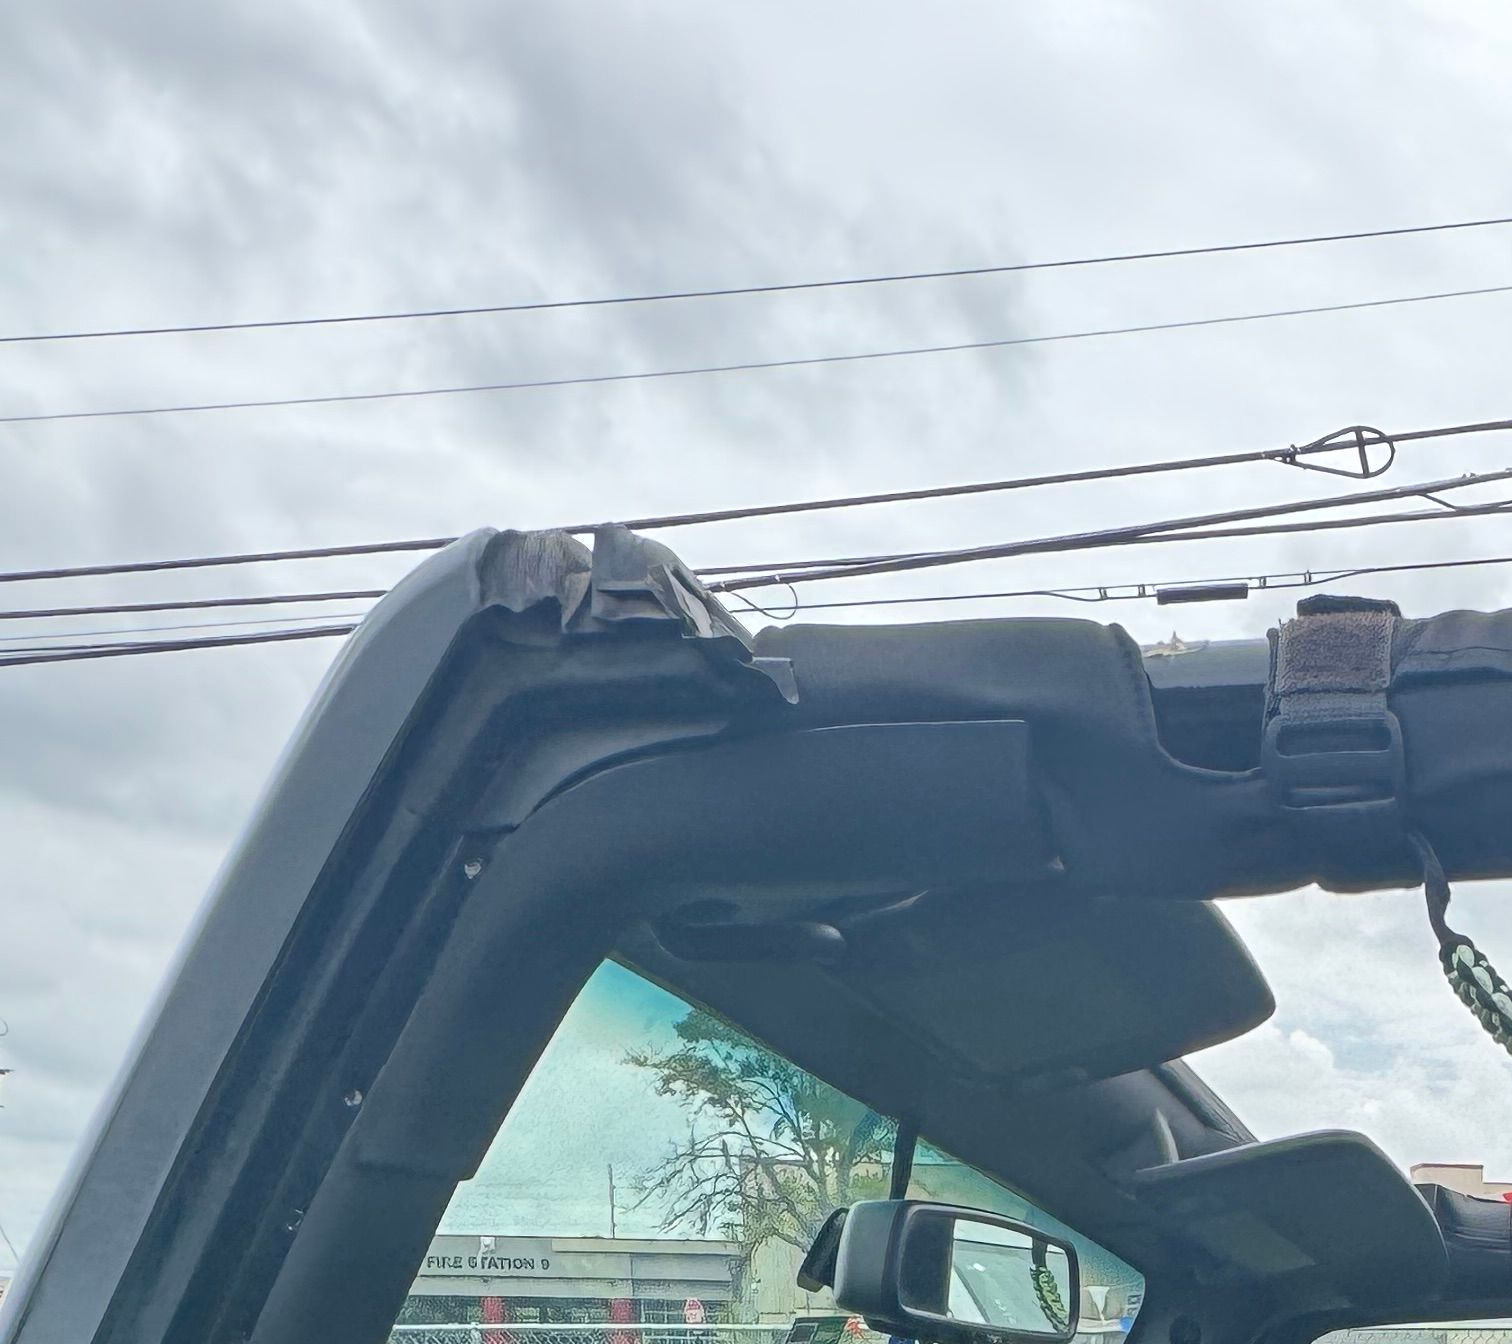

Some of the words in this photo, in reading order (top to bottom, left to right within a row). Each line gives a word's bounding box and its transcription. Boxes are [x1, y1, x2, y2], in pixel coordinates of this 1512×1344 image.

[426, 1256, 463, 1269] FIRE
[468, 1256, 535, 1271] STATION
[541, 1258, 550, 1271] 9
